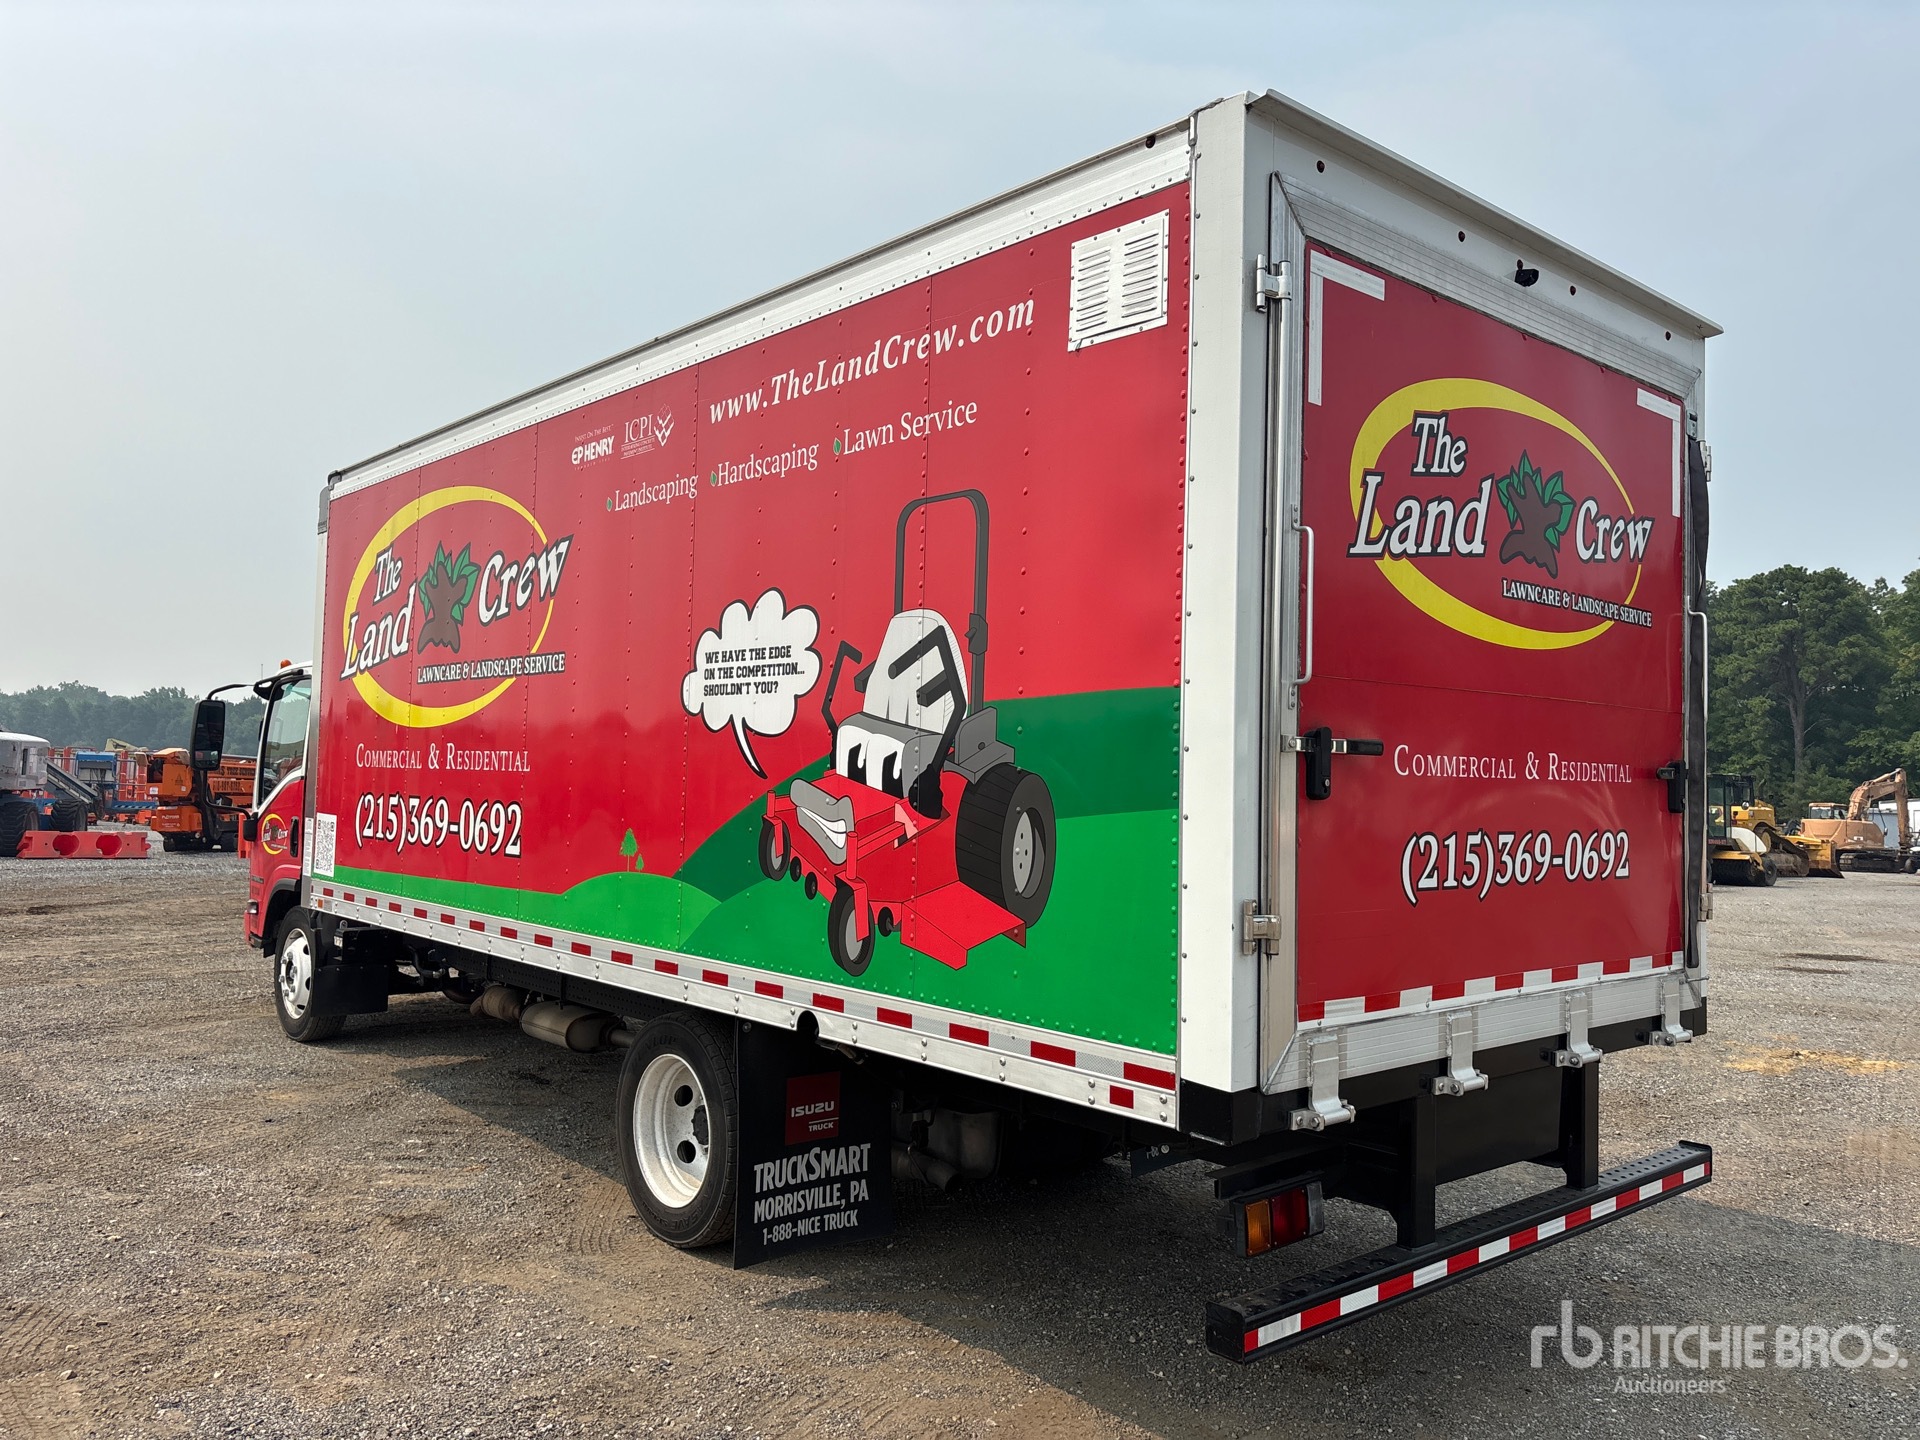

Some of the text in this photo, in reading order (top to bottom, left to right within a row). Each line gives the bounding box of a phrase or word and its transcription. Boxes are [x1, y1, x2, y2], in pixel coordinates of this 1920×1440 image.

[709, 299, 1034, 424] www.TheLandCrew.com
[624, 413, 654, 443] ICPI
[843, 400, 978, 455] Lawn Service
[1413, 414, 1468, 475] The
[584, 435, 615, 462] HENRY
[717, 443, 819, 487] Hardscaping
[615, 474, 699, 511] Landscaping
[1349, 473, 1654, 562] Land Crew
[373, 544, 403, 605] The
[341, 539, 572, 680] Land Crew
[1502, 579, 1652, 629] LAWNCARE & LANDSCAPE SERVICE
[417, 653, 566, 684] LAWNCARE & LANDSCAPE SERVICE
[704, 662, 805, 680] ON THE COMPETITION...
[705, 645, 792, 664] WE HAVE THE EDGE
[703, 680, 779, 697] SHOULDN'T YOU?
[428, 742, 439, 770] &
[1525, 751, 1540, 780] &
[355, 792, 523, 859] (215)369-0692
[1401, 828, 1631, 907] (215)369-0692
[791, 1100, 835, 1117] ISUZU
[808, 1121, 834, 1132] TRUCK
[754, 1179, 869, 1224] MORRISVILLE, PA
[762, 1209, 858, 1246] 1-888-NICE TRUCK
